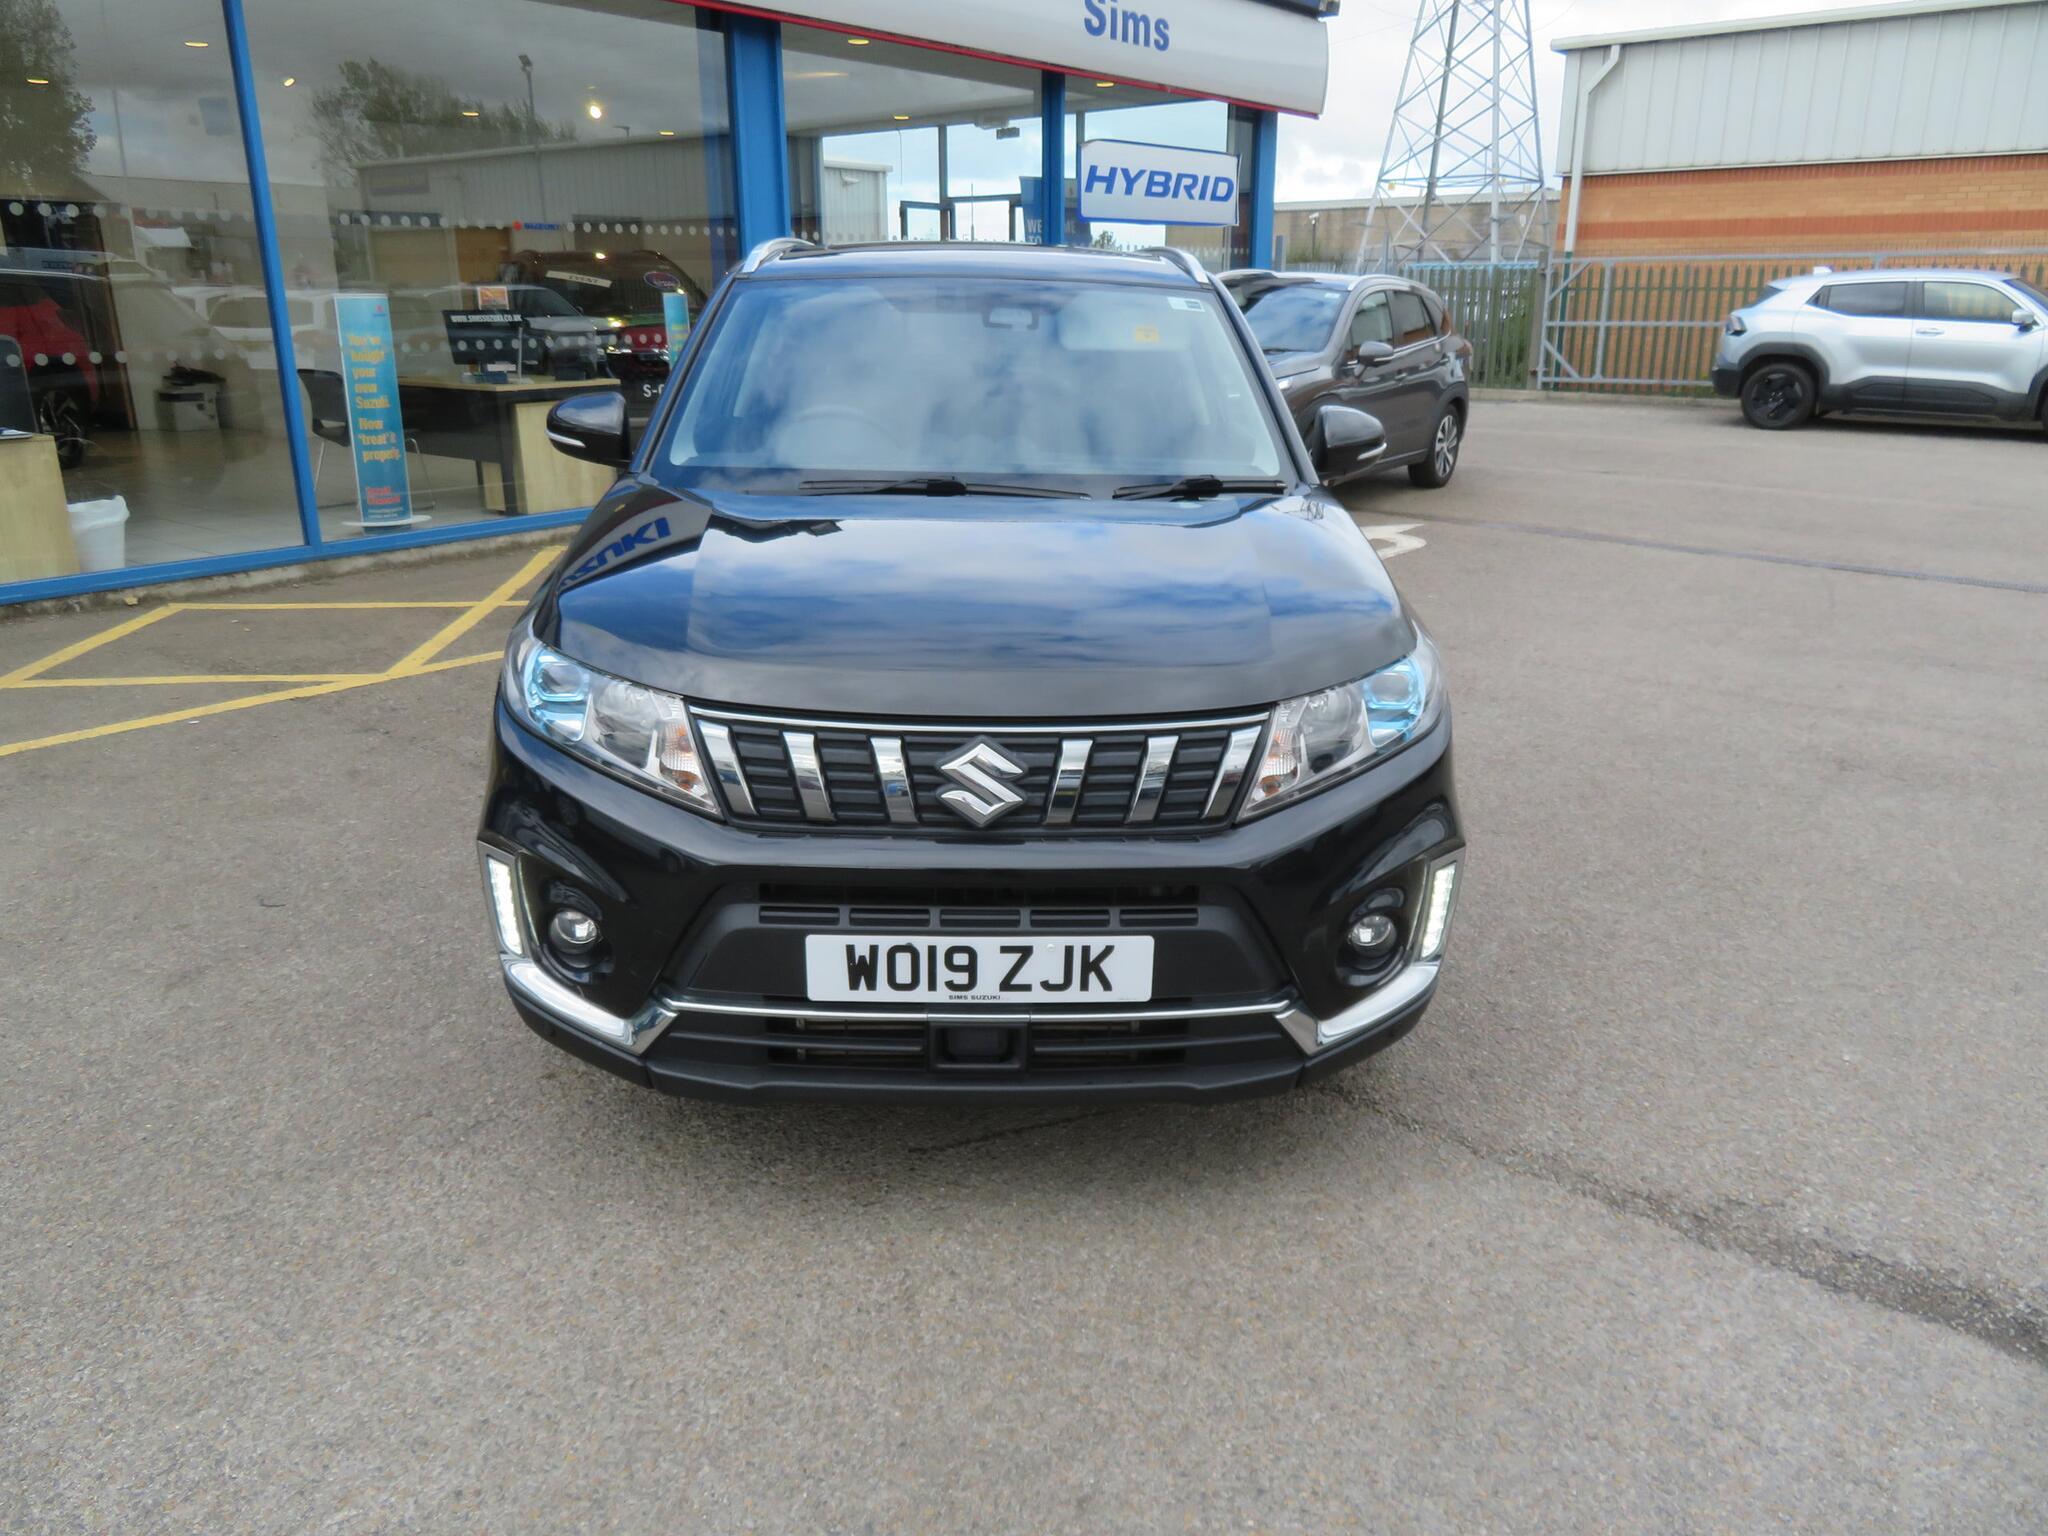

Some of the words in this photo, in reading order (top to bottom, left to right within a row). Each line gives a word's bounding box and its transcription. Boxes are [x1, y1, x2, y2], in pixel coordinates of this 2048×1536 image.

[1084, 0, 1170, 51] Sims
[1084, 165, 1235, 203] HYBRID
[845, 944, 978, 992] WO19
[999, 944, 1115, 992] ZJK
